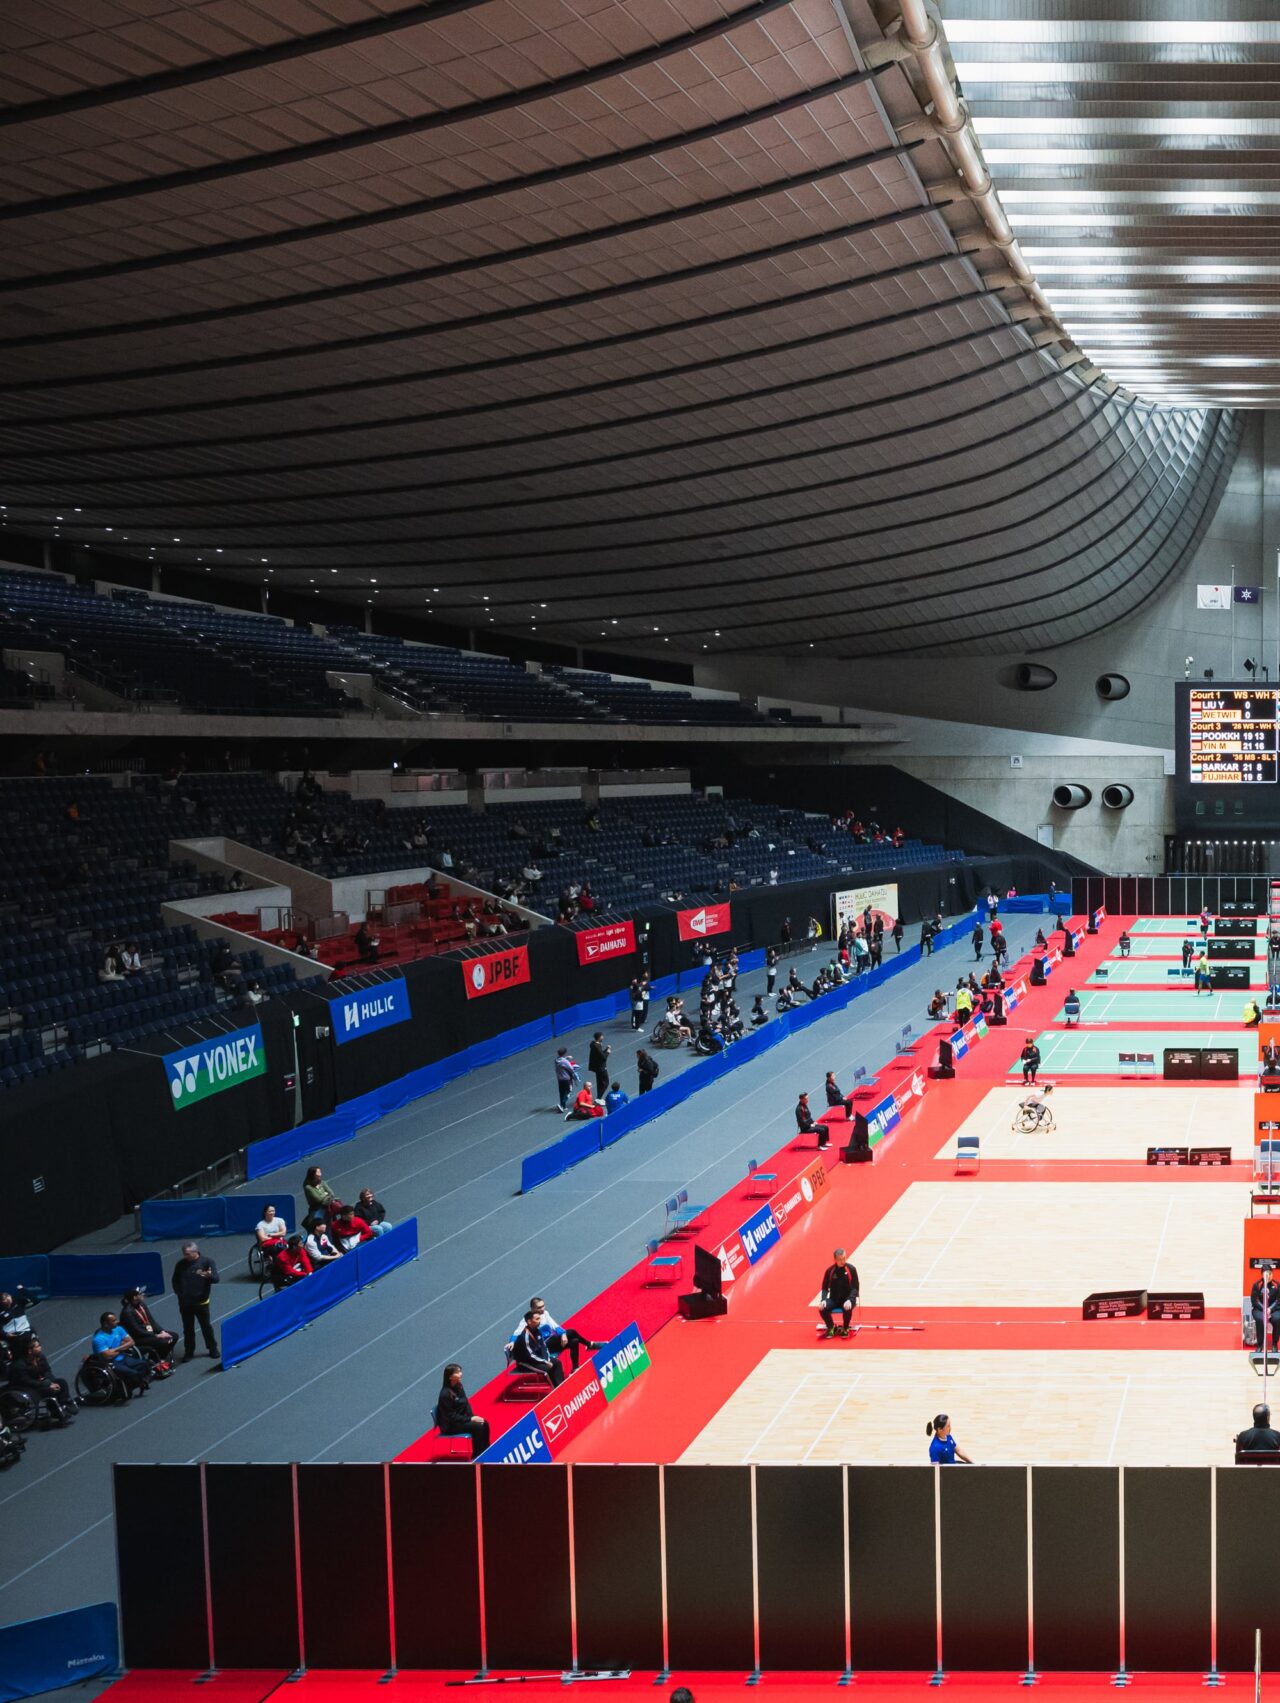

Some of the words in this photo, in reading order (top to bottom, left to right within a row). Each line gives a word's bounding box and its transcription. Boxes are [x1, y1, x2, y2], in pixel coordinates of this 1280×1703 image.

[1191, 691, 1214, 699] Court
[1202, 701, 1216, 709] LIU
[1218, 701, 1224, 709] Y
[1244, 701, 1250, 710] 0
[1244, 711, 1250, 720] 0
[1202, 732, 1240, 740] POOKKH
[1254, 732, 1264, 740] 13
[1202, 764, 1239, 772] SARKAR
[1243, 764, 1252, 772] 21
[600, 938, 626, 952] DAIHATSU
[489, 956, 520, 984] JPBF
[362, 996, 394, 1020] HULIC
[203, 1034, 260, 1084] YONEX
[753, 1214, 776, 1244] HULIC
[613, 1336, 644, 1374] YONEX
[564, 1379, 600, 1420] DAIHATSU
